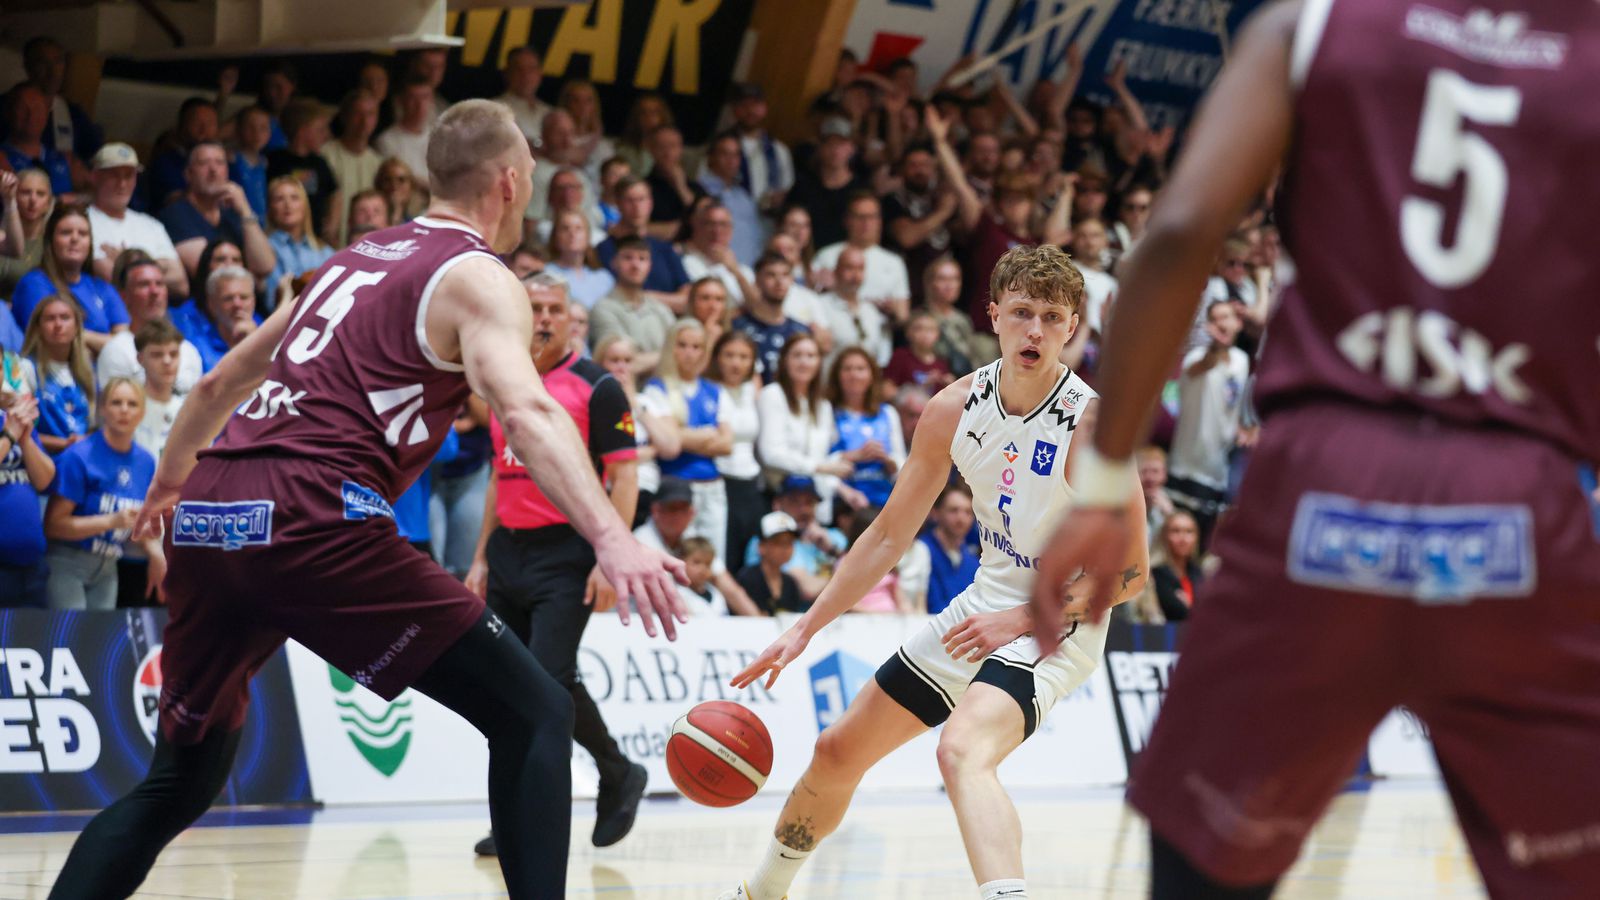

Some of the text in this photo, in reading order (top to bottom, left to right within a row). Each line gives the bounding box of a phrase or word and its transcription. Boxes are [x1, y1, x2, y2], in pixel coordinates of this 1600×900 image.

[1401, 69, 1522, 289] 5
[270, 264, 388, 365] 15
[1067, 388, 1084, 402] PK
[1108, 652, 1181, 692] BET
